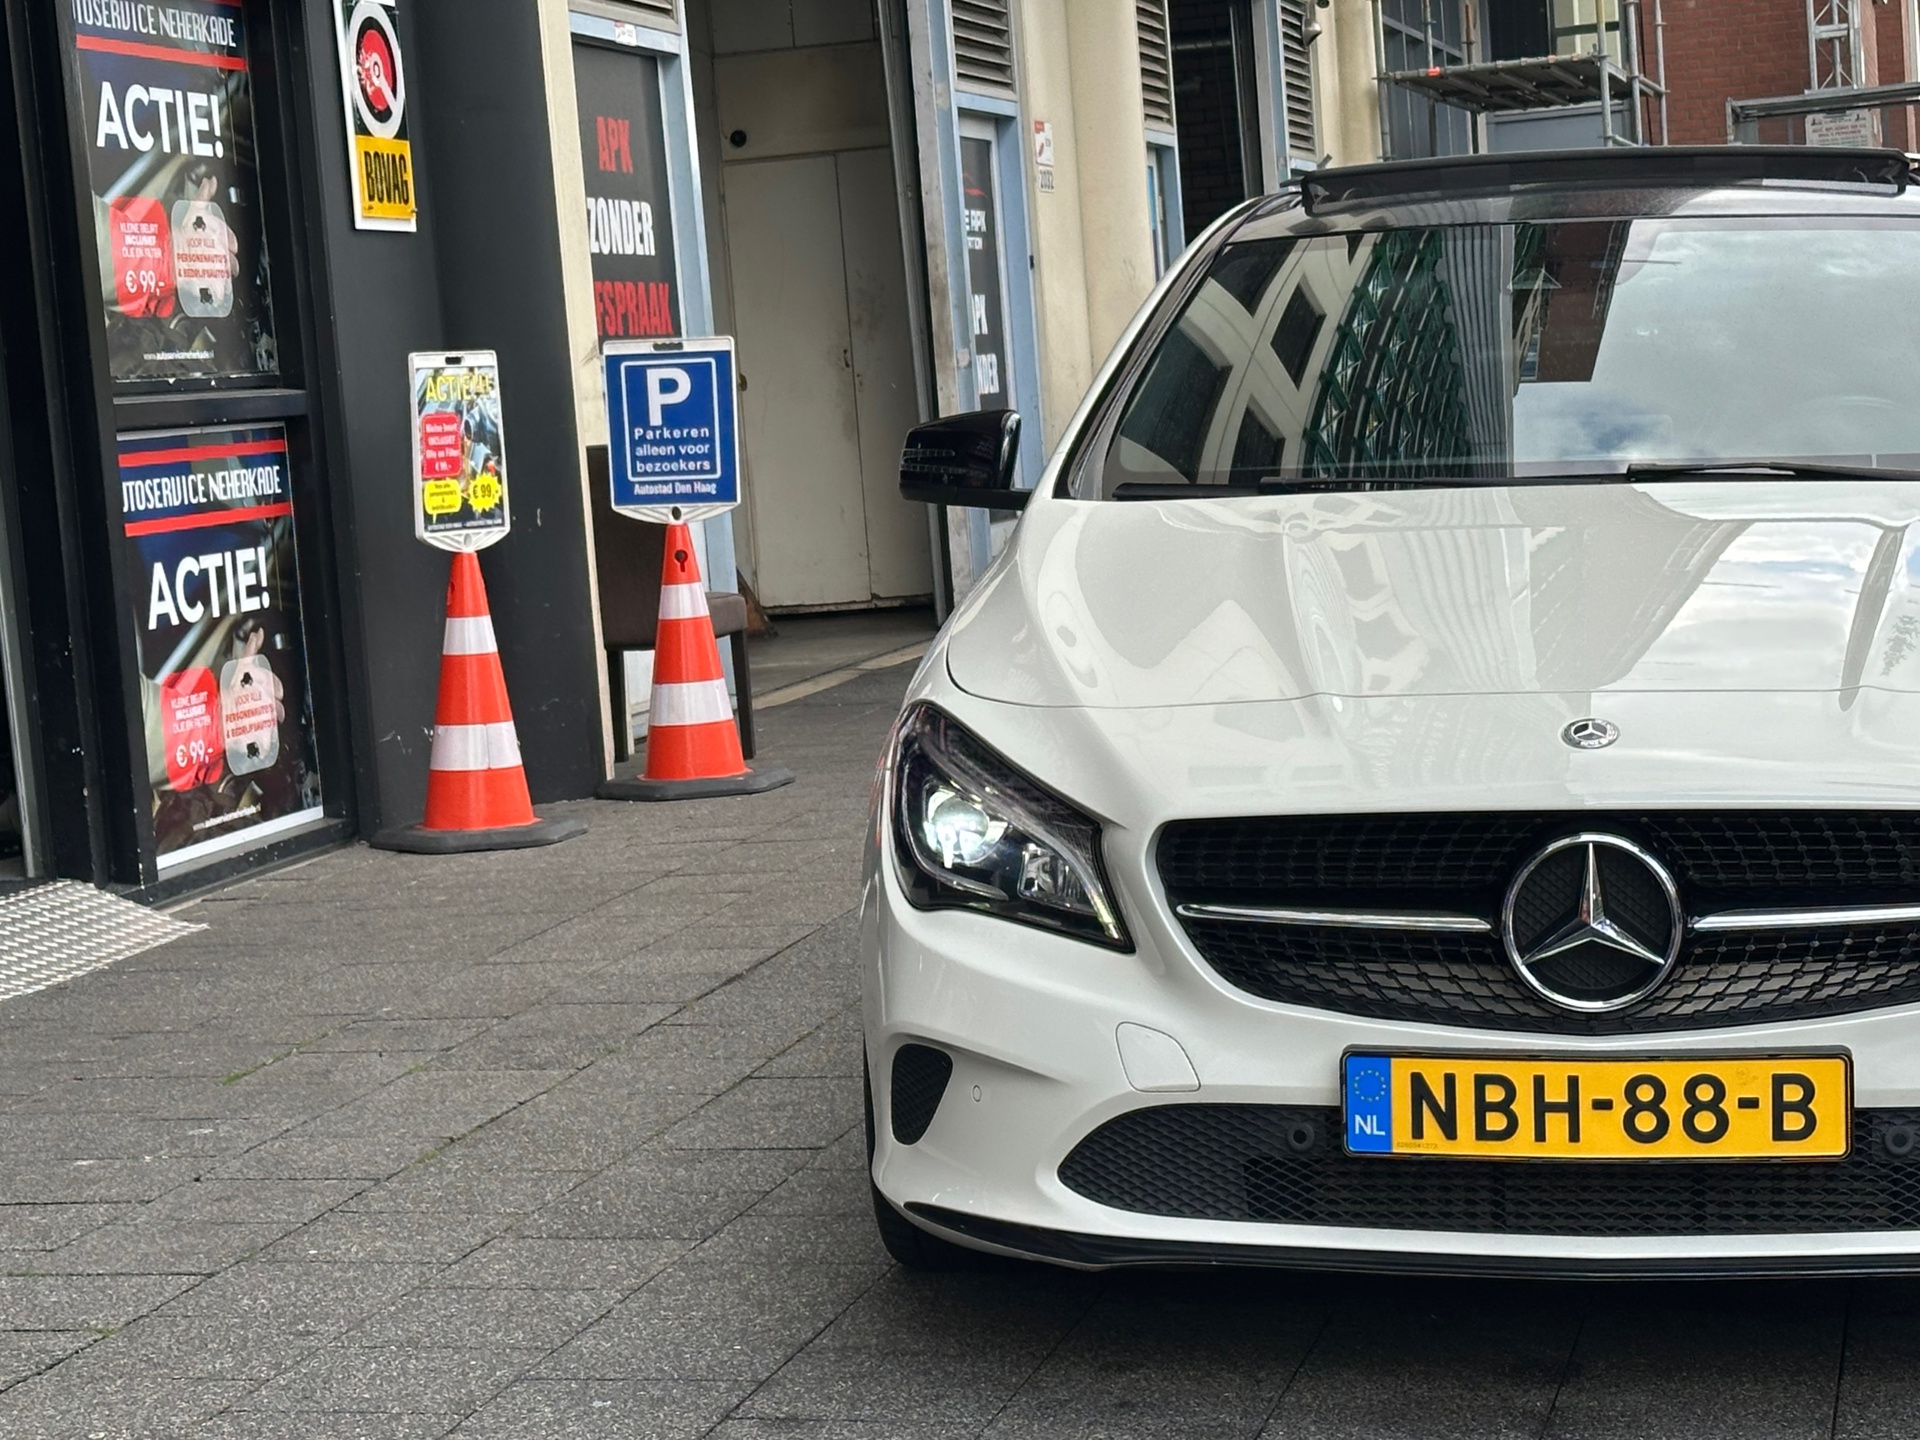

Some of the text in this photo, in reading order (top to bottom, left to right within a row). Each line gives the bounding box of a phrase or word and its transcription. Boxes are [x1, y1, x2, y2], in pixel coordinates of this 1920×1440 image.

[158, 7, 237, 47] NEHERKADE
[96, 81, 224, 159] ACTIE!
[596, 116, 633, 174] APK
[364, 150, 409, 205] BOVAG
[587, 197, 655, 256] ZONDER
[125, 270, 165, 297] € 99,-
[646, 367, 692, 427] P
[634, 427, 710, 440] Parkeren
[635, 444, 710, 457] alleen voor
[208, 465, 282, 502] NEHERKADE
[636, 459, 711, 473] bezoekers
[634, 482, 717, 495] Autostad Den Haag
[148, 546, 270, 631] ACTIE!
[176, 739, 214, 767] € 99,-
[1355, 1114, 1385, 1136] NL
[1410, 1071, 1818, 1145] NBH-88-B
